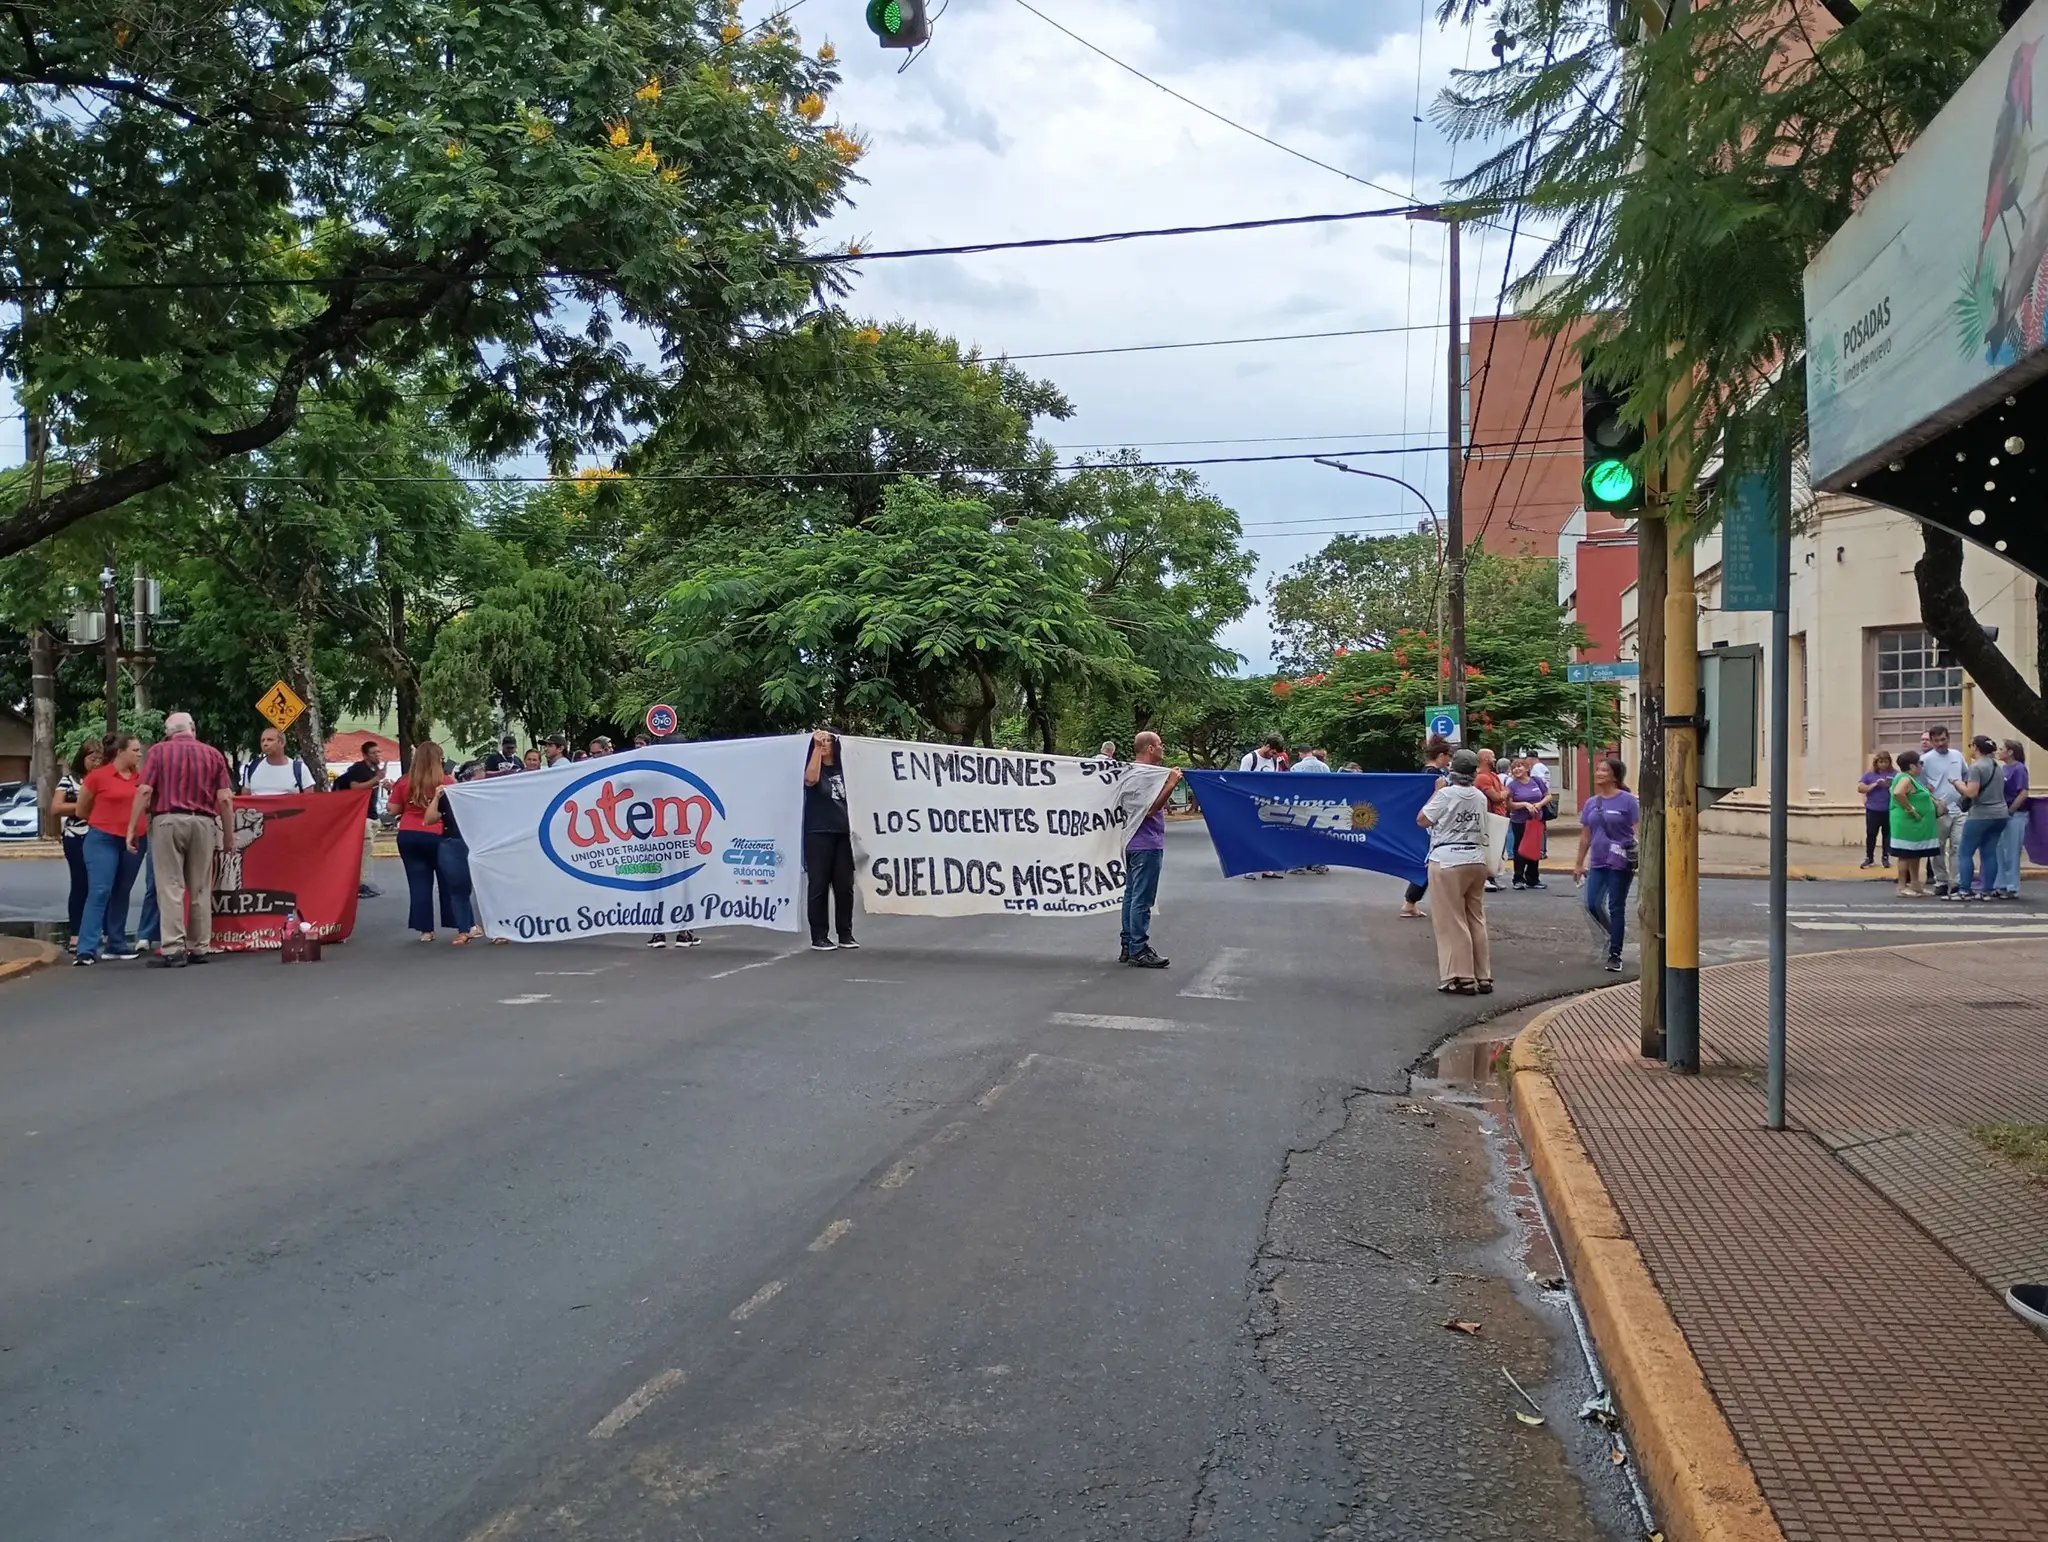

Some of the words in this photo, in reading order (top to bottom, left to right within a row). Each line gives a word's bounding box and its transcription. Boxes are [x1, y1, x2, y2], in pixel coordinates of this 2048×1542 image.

[1844, 296, 1891, 359] POSADAS
[1593, 669, 1614, 677] Colón
[1437, 720, 1448, 734] E
[564, 780, 713, 855] utem
[873, 809, 921, 835] LOS
[928, 808, 1039, 833] DOCENTES
[1258, 804, 1353, 831] CTA
[571, 850, 605, 863] UNION
[607, 846, 621, 856] DE
[622, 840, 696, 855] TRABAJADORES
[731, 837, 774, 850] Misiones
[589, 859, 604, 869] DE
[606, 856, 620, 866] LA
[675, 850, 690, 860] DE
[723, 849, 776, 866] CTA
[615, 862, 662, 875] MISIONES
[872, 857, 1006, 897] SUELDOS
[1004, 899, 1038, 910] CTA
[577, 901, 664, 930] Sociedad
[670, 903, 694, 924] es
